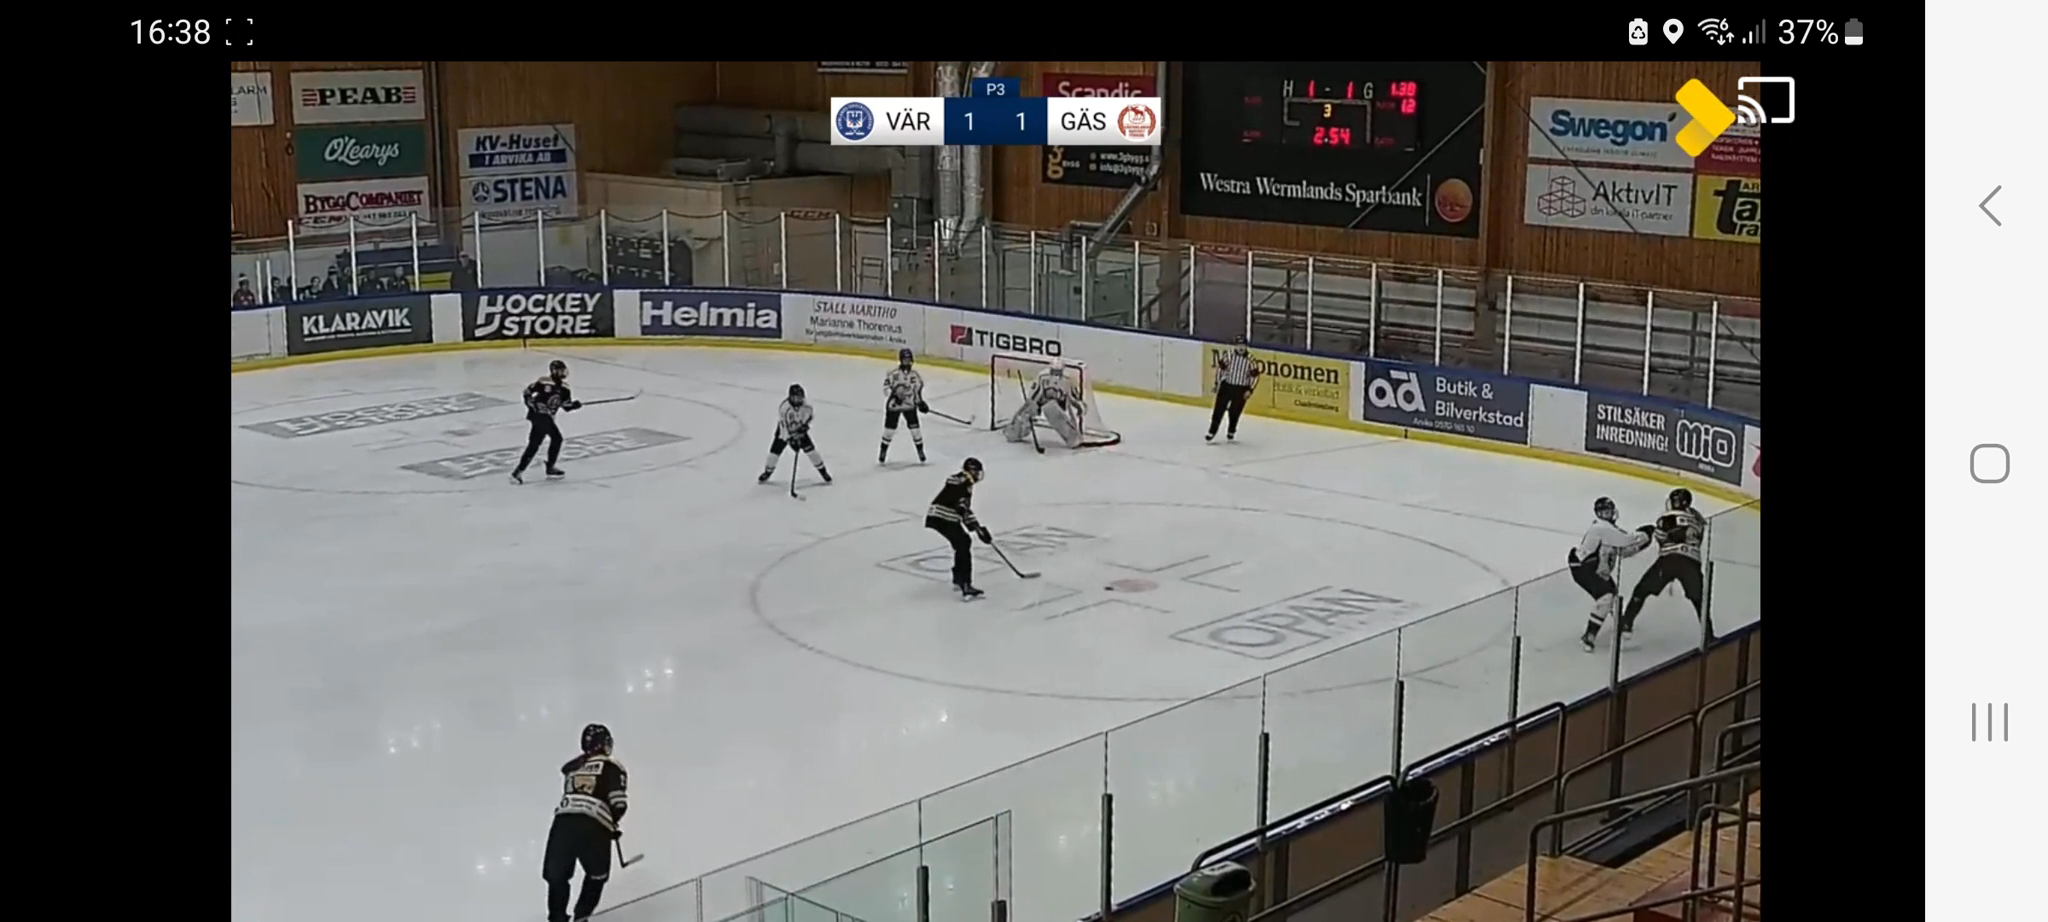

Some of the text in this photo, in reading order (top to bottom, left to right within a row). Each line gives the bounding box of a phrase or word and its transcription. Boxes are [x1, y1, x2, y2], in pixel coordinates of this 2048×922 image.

[317, 86, 403, 106] PEAB
[1283, 80, 1294, 97] H
[1363, 82, 1374, 99] G
[1322, 104, 1332, 118] 3
[1313, 127, 1351, 144] 2.54
[1549, 109, 1668, 146] Swegon
[324, 135, 399, 166] O'Learys
[475, 133, 559, 152] KV-Huset
[491, 153, 534, 166] ARVIKA
[493, 175, 567, 203] STENA
[1200, 172, 1422, 208] Westra Wermlands Sparbank
[1592, 180, 1679, 207] AktivIT
[302, 307, 411, 335] KLARAVIK
[475, 292, 602, 327] HOCKEY
[642, 301, 778, 328] Helmia
[815, 301, 897, 319] STALL MARITHO
[502, 314, 593, 336] STORE
[810, 316, 902, 333] Marianne Thorenius
[975, 329, 1062, 357] TIGBRO
[1436, 376, 1494, 400] Butik &
[1435, 400, 1524, 427] Bilverkstad
[1597, 404, 1665, 431] STILSÄKER
[1596, 424, 1669, 452] INREDNING!
[1208, 588, 1402, 647] OPAN
